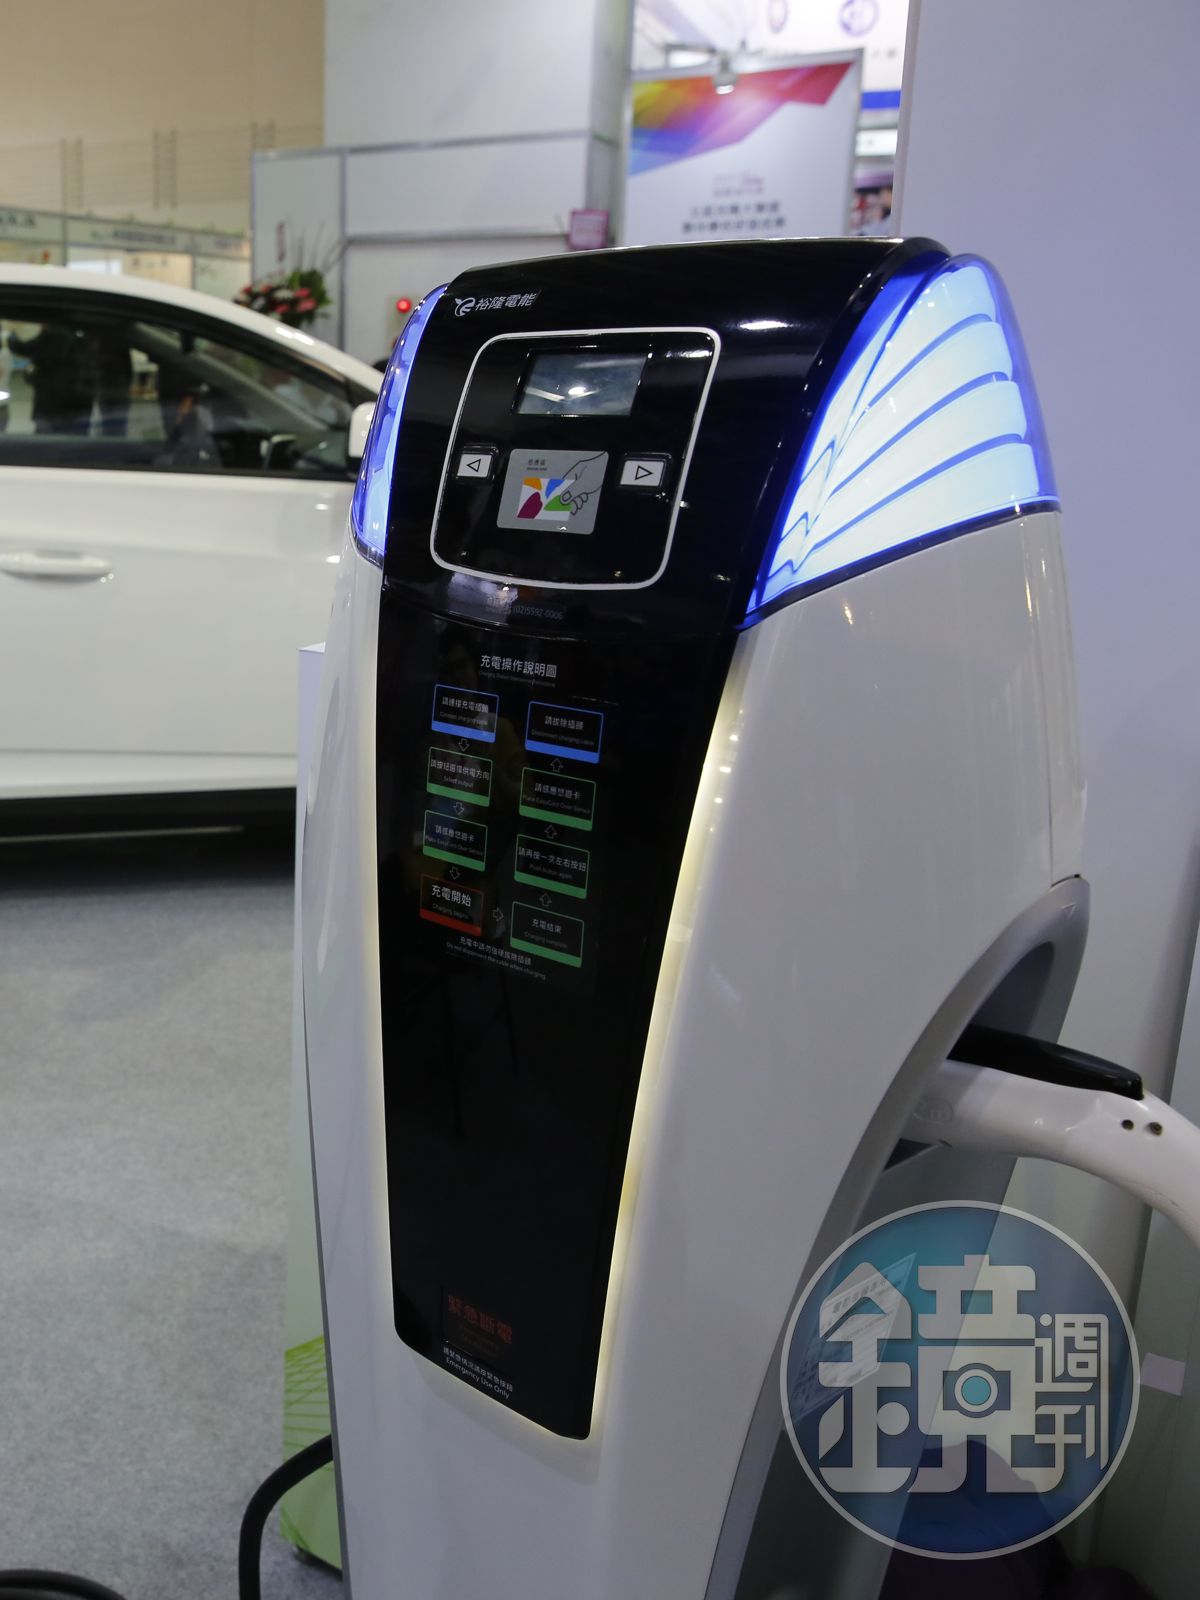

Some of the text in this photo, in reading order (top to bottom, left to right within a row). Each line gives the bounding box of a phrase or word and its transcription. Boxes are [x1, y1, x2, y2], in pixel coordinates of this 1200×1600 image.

[475, 293, 536, 311] 裕隆電能
[480, 655, 557, 678] 充電操作說明圖
[431, 884, 472, 907] 充電開始
[445, 1356, 510, 1399] Emergency Use Only
